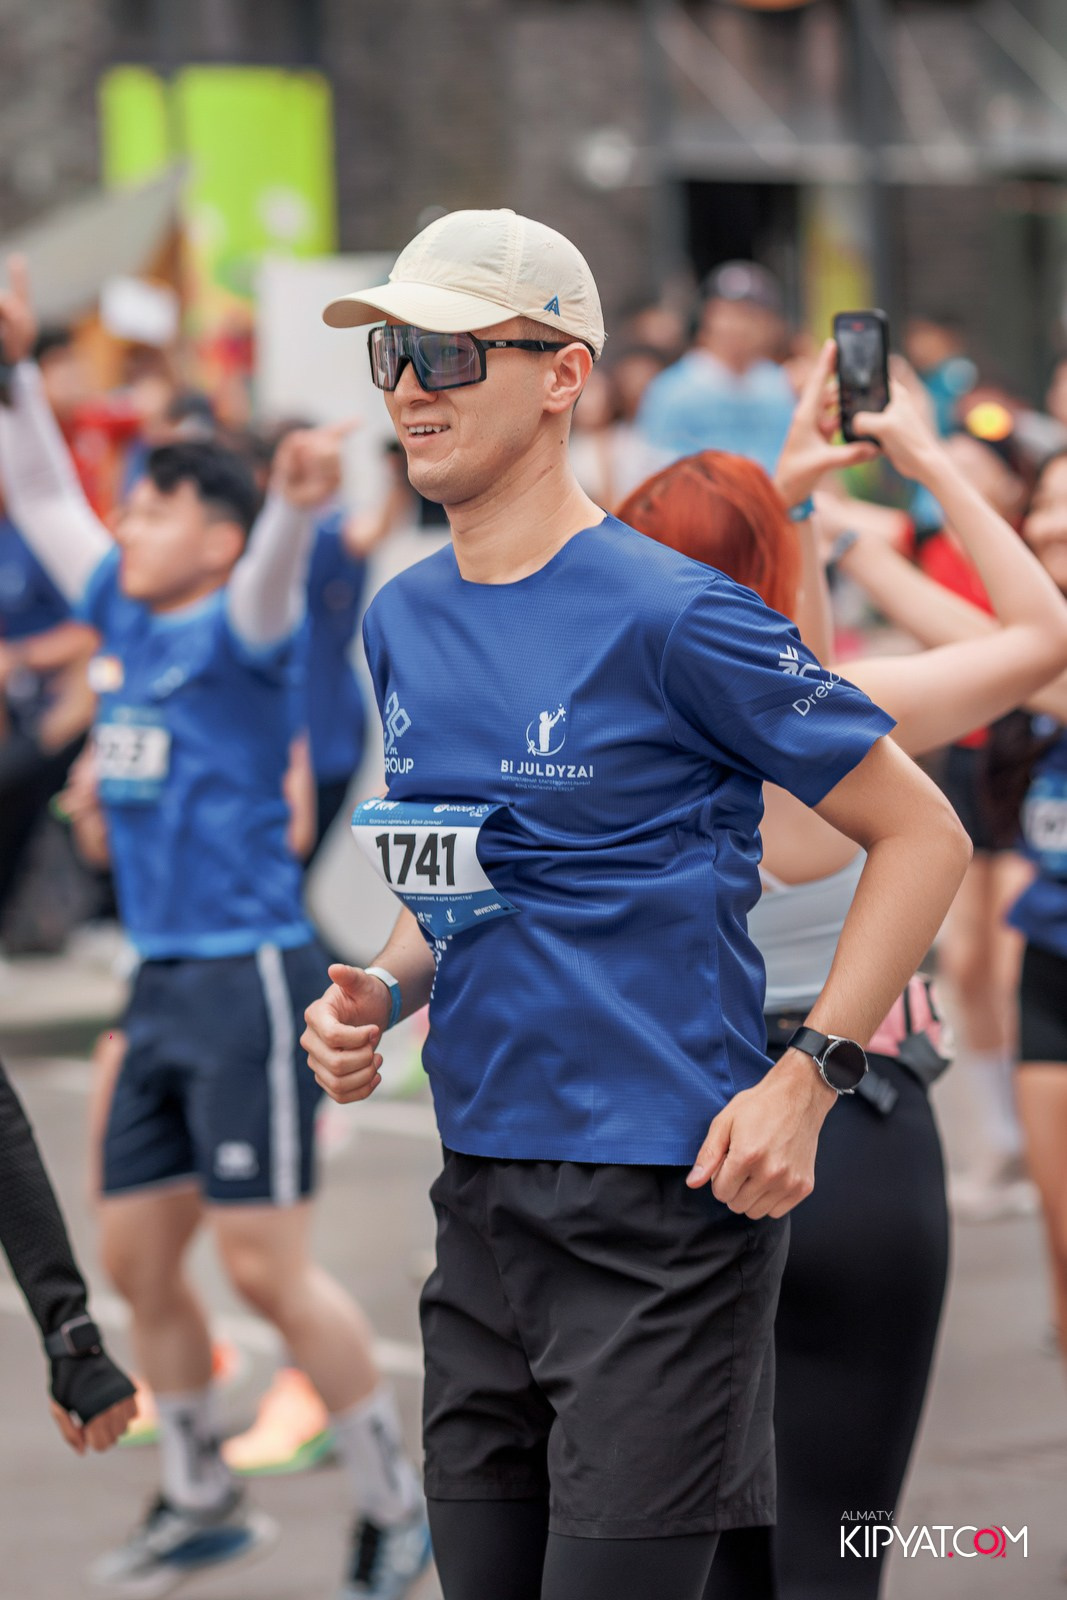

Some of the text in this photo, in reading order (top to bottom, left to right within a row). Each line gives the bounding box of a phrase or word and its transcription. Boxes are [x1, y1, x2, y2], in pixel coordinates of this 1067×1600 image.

[385, 757, 414, 774] ROUP
[500, 759, 594, 778] BI JULDYZAI
[375, 833, 457, 886] 1741
